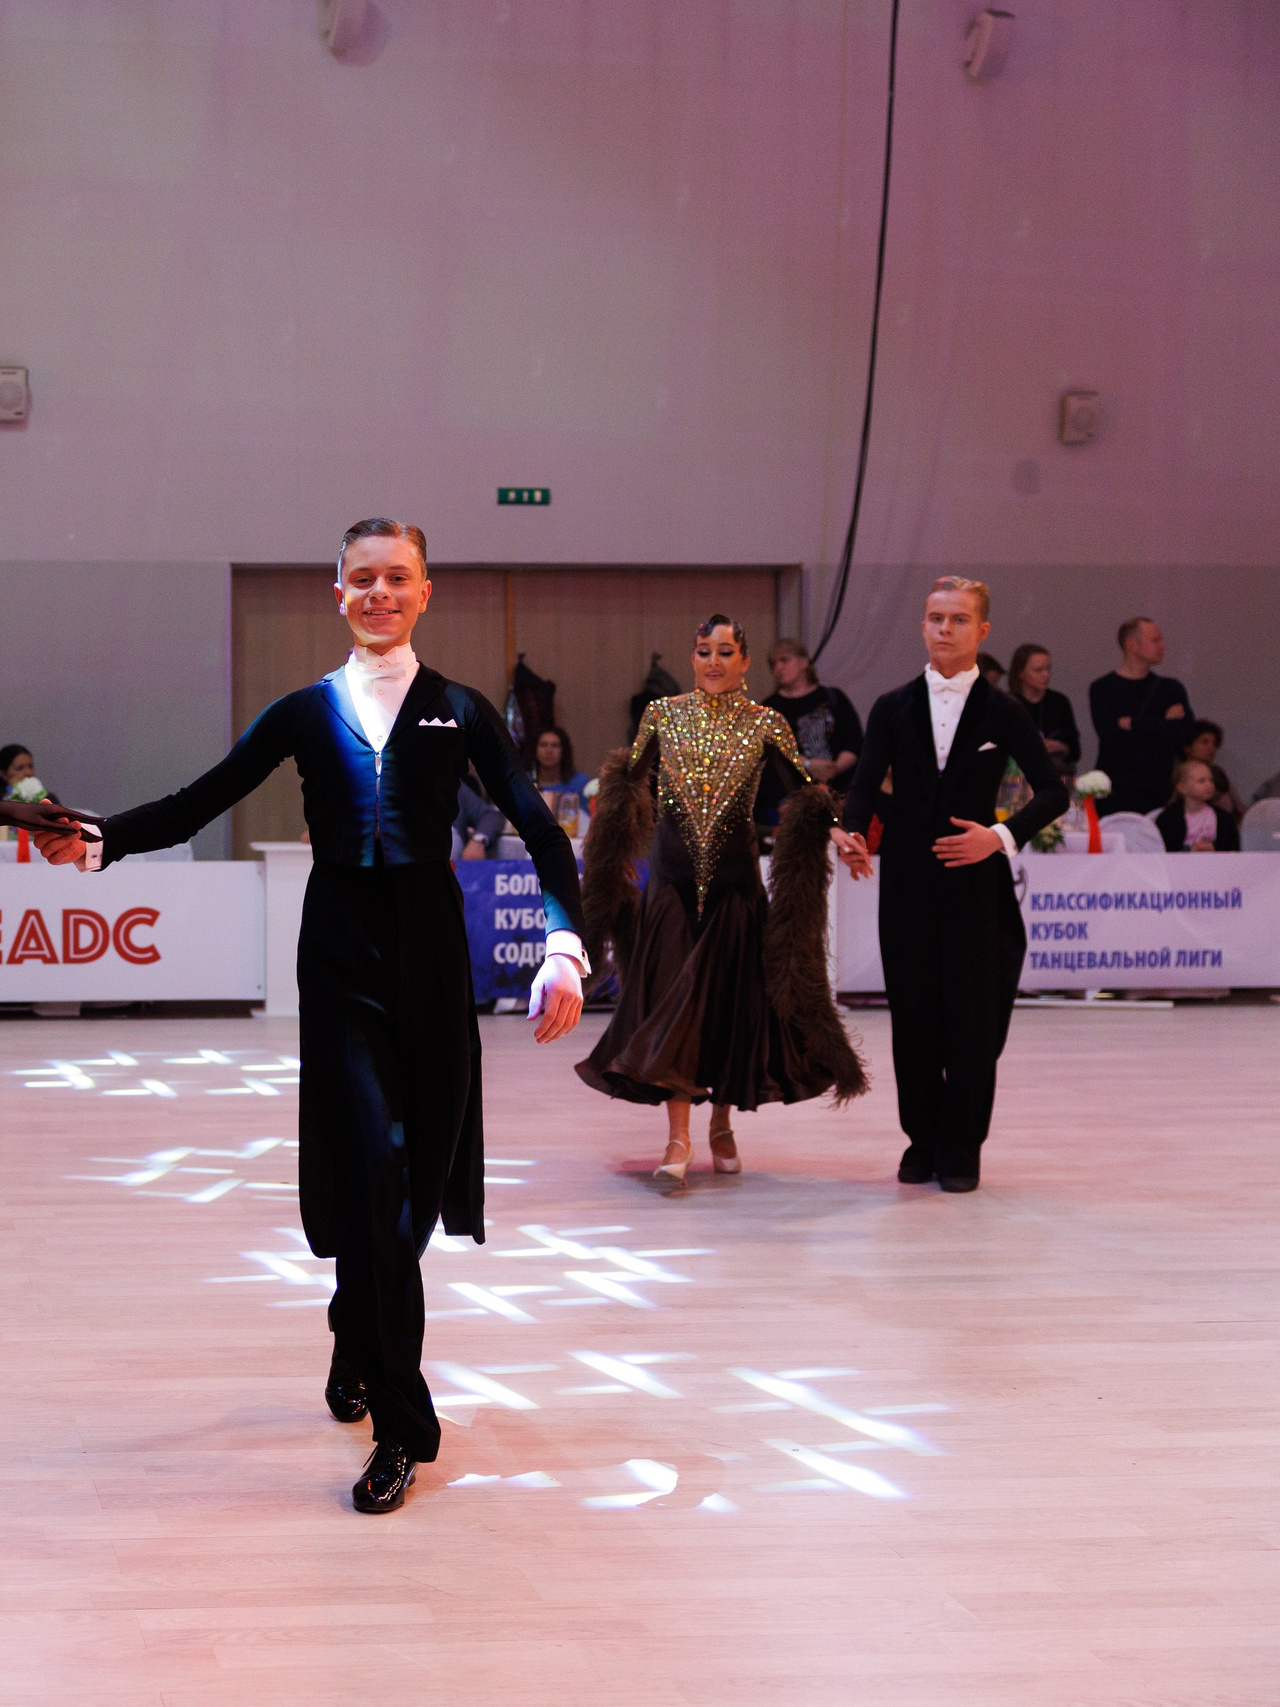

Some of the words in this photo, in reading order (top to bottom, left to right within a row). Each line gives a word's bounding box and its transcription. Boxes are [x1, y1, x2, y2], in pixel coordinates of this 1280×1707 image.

[495, 874, 541, 895] БОЛ
[1031, 887, 1242, 913] КЛАССИФИКАЦИОННЫЙ
[494, 908, 546, 930] КУБО
[1031, 922, 1089, 940] КУБОК
[493, 942, 545, 968] СОДР
[1031, 947, 1171, 972] ТАНЦЕВАЛЬНОЙ
[1175, 949, 1222, 968] ЛИГИ
